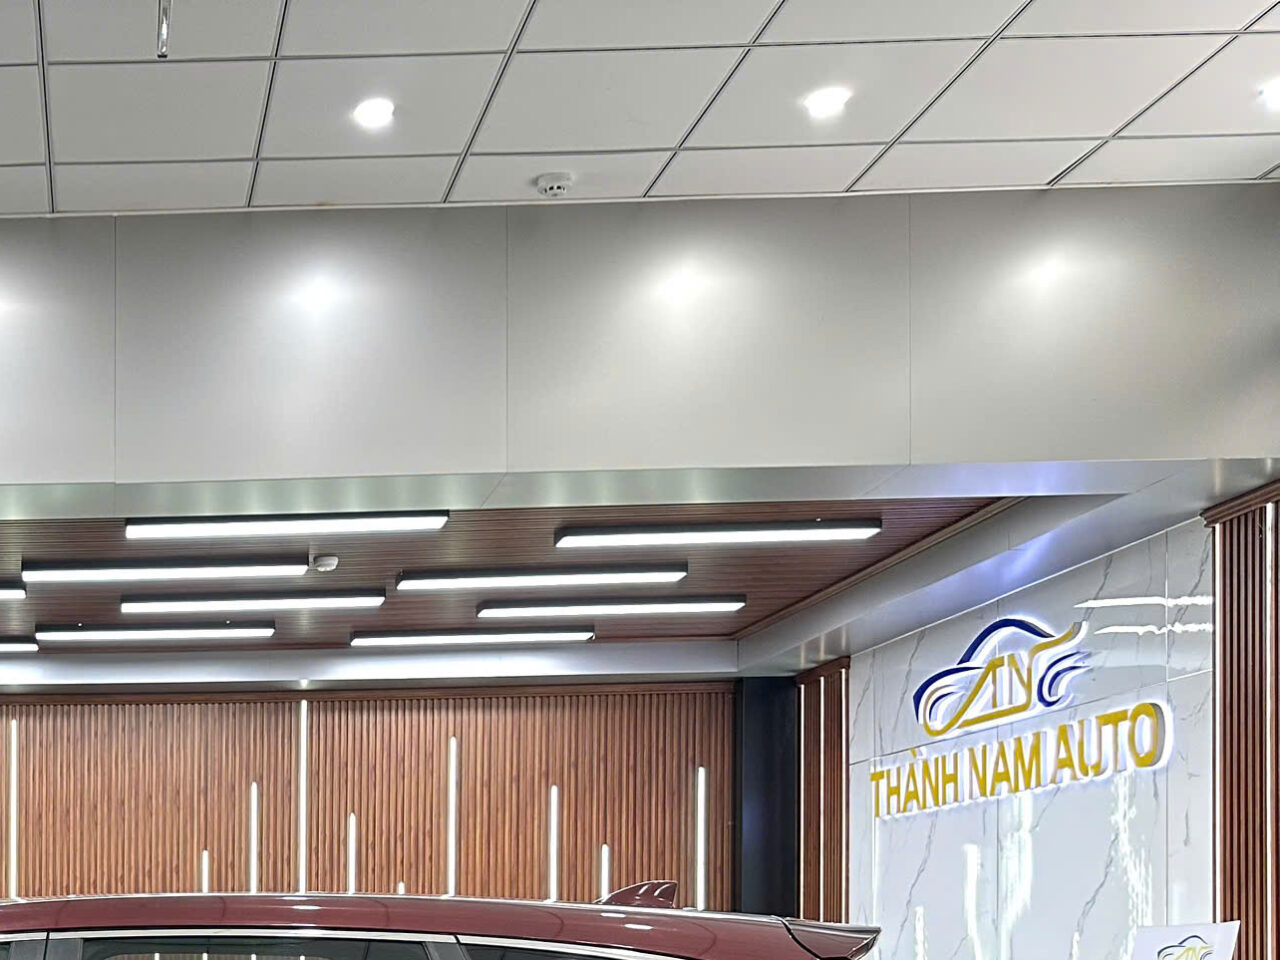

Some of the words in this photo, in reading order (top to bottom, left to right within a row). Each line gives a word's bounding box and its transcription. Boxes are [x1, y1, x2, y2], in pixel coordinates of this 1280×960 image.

[870, 747, 959, 818] THÀNH
[968, 731, 1041, 801] NAM
[1052, 702, 1163, 783] AUTO
